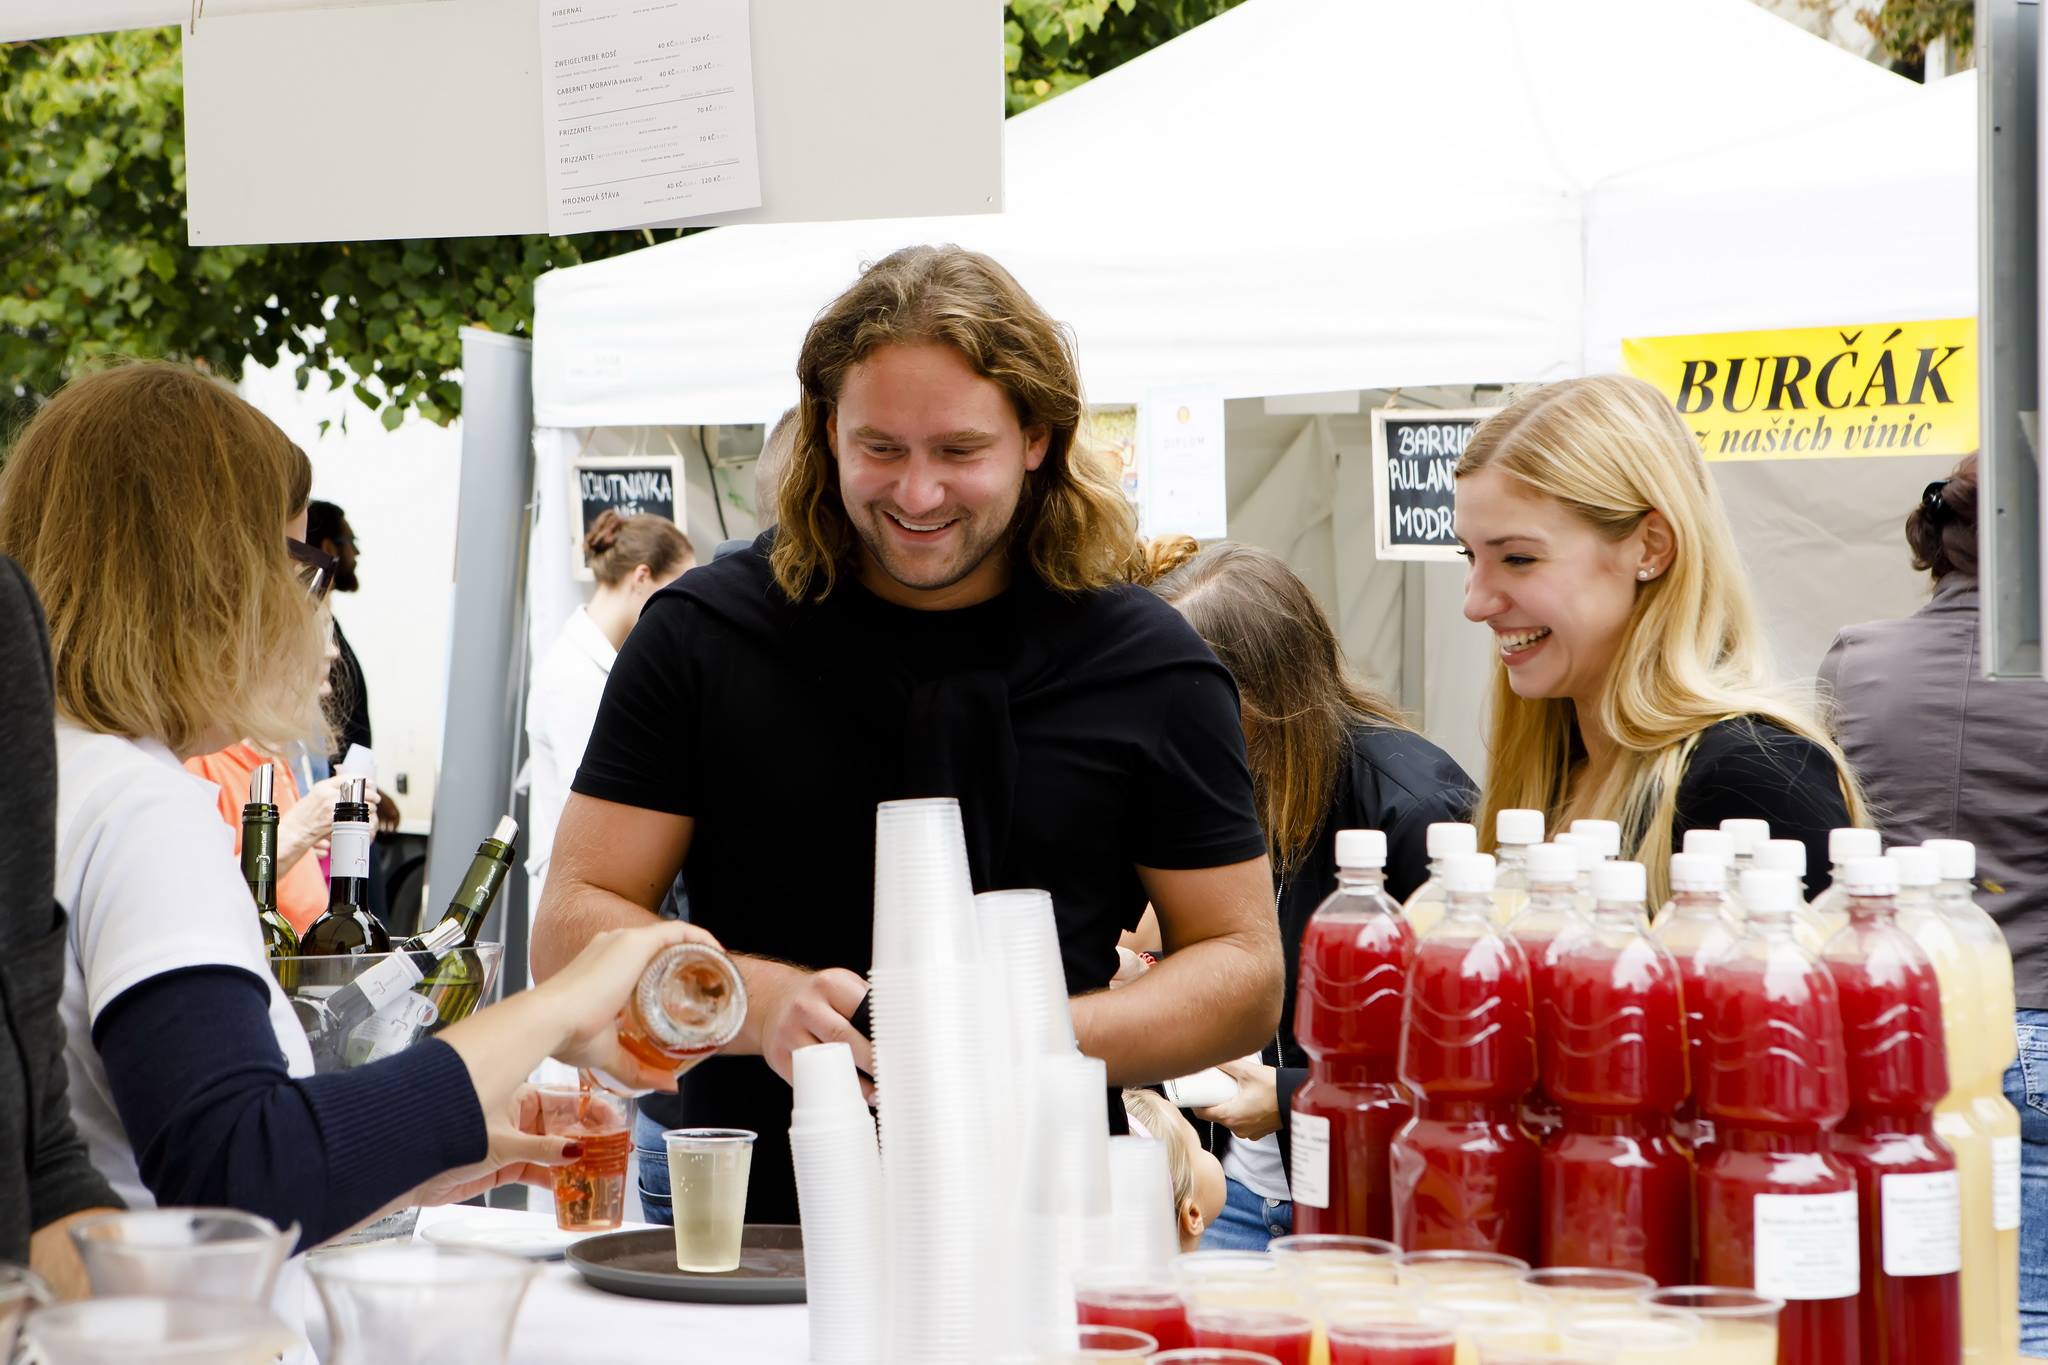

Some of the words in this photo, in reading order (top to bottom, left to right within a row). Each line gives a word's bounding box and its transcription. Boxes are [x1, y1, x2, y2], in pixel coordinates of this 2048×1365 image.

[552, 7, 583, 17] HIBERNAL
[554, 53, 599, 68] ZWEIGELTREBE
[690, 36, 702, 44] 250
[556, 84, 588, 96] CABERNET
[589, 79, 619, 90] MORAVIA
[692, 64, 703, 72] 250
[559, 125, 593, 137] FRIZZANTE
[560, 153, 595, 165] FRIZZANTE
[699, 135, 707, 143] 70
[1676, 328, 1966, 415] BURČÁK
[1719, 415, 1833, 454] našich
[1843, 413, 1932, 450] vinic
[1395, 504, 1457, 541] MODR
